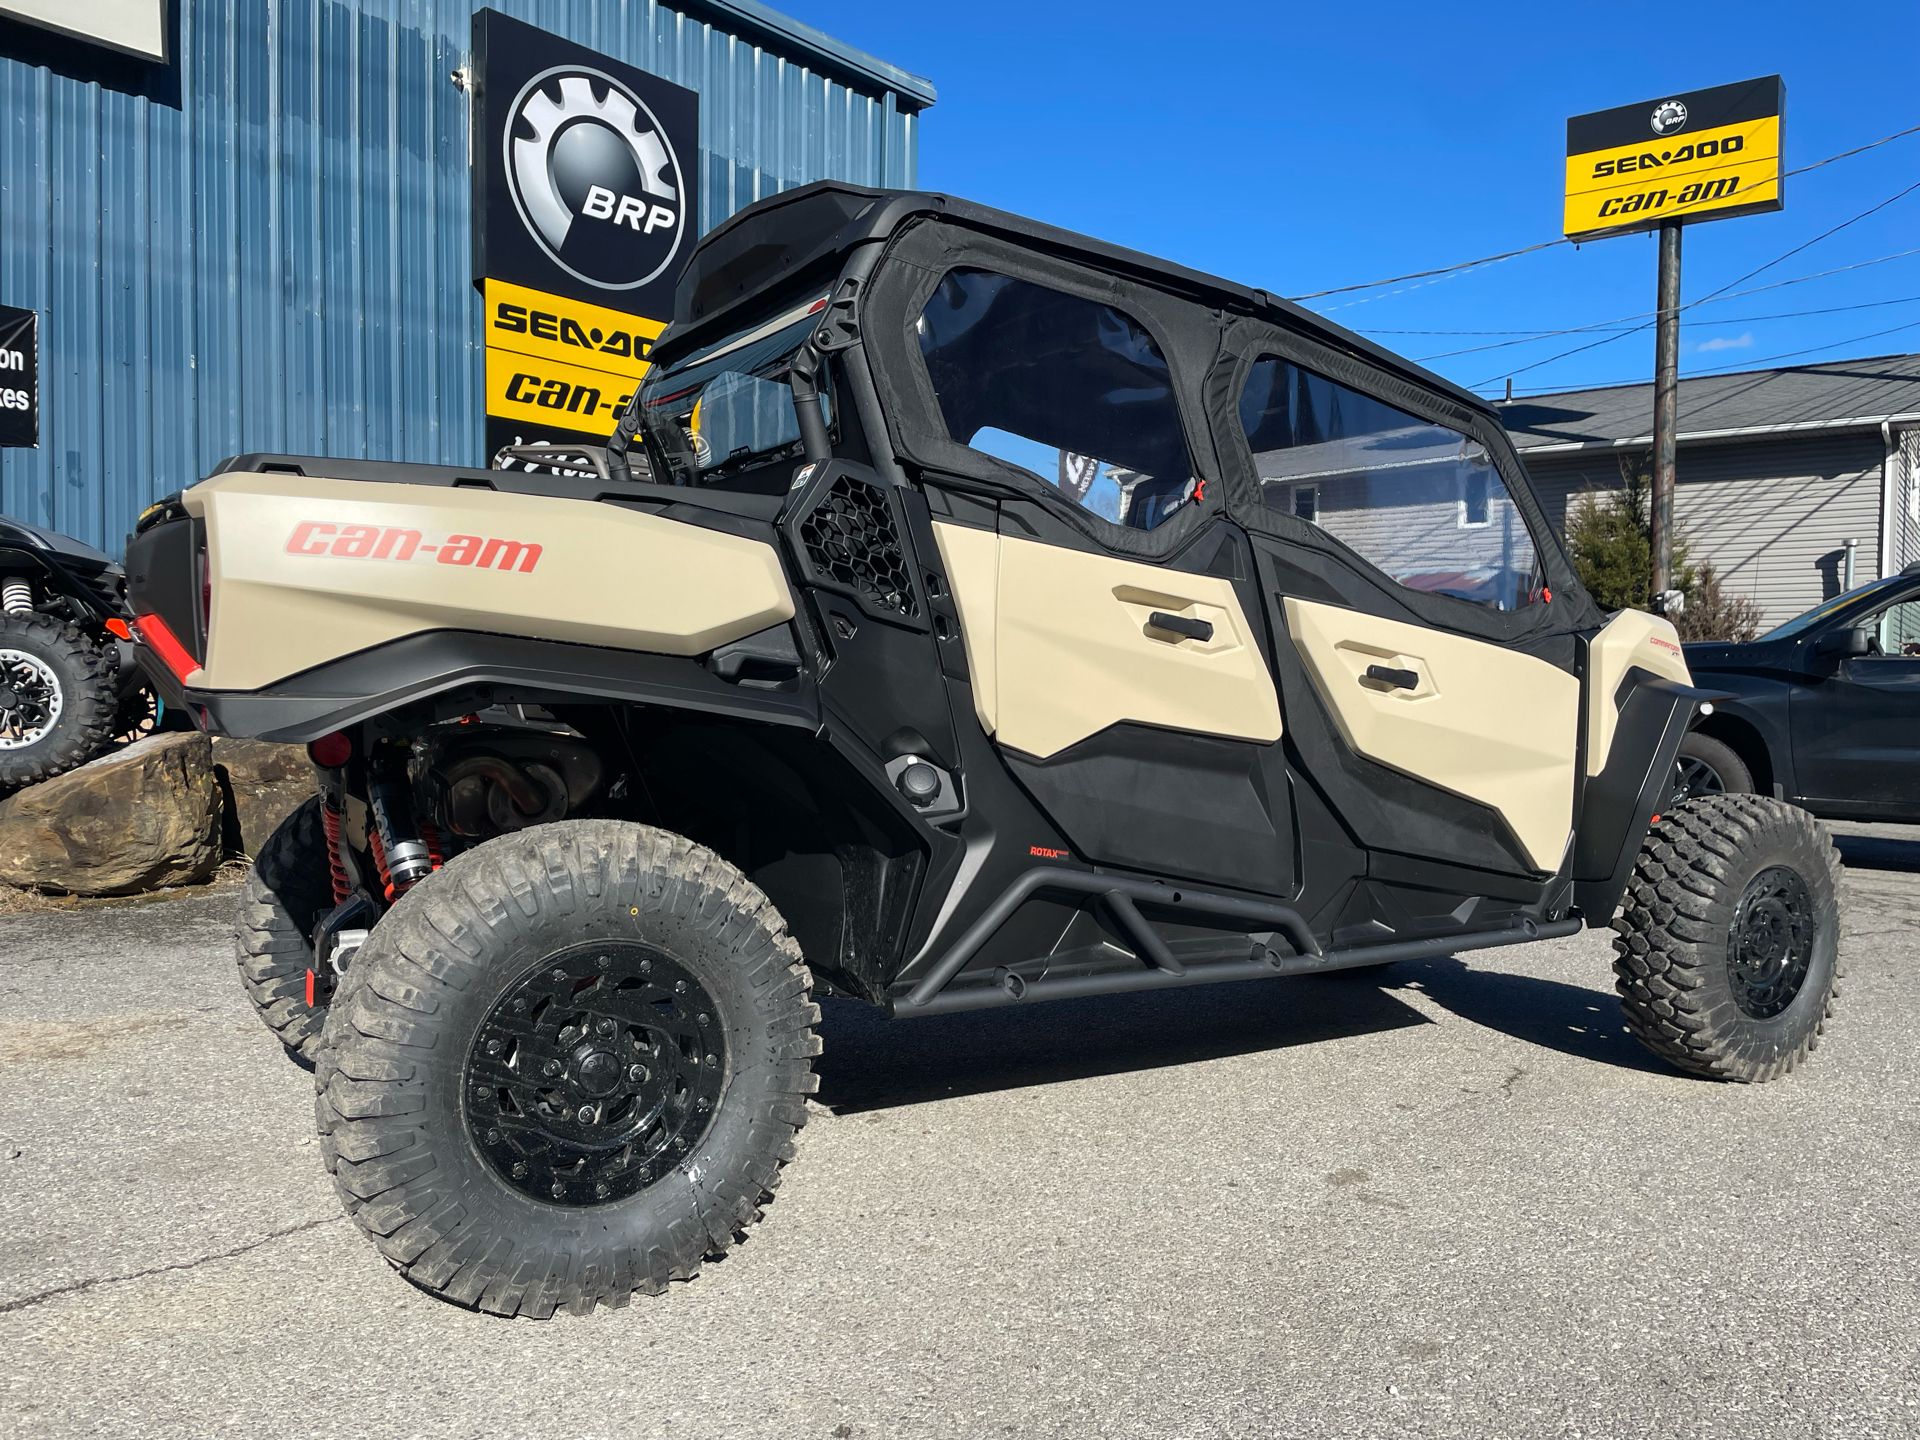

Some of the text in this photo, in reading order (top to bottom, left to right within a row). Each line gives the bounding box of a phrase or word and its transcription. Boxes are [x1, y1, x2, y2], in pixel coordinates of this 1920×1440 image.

[1665, 115, 1685, 126] BRP
[582, 184, 676, 235] BRP
[1030, 846, 1058, 858] ROTAX
